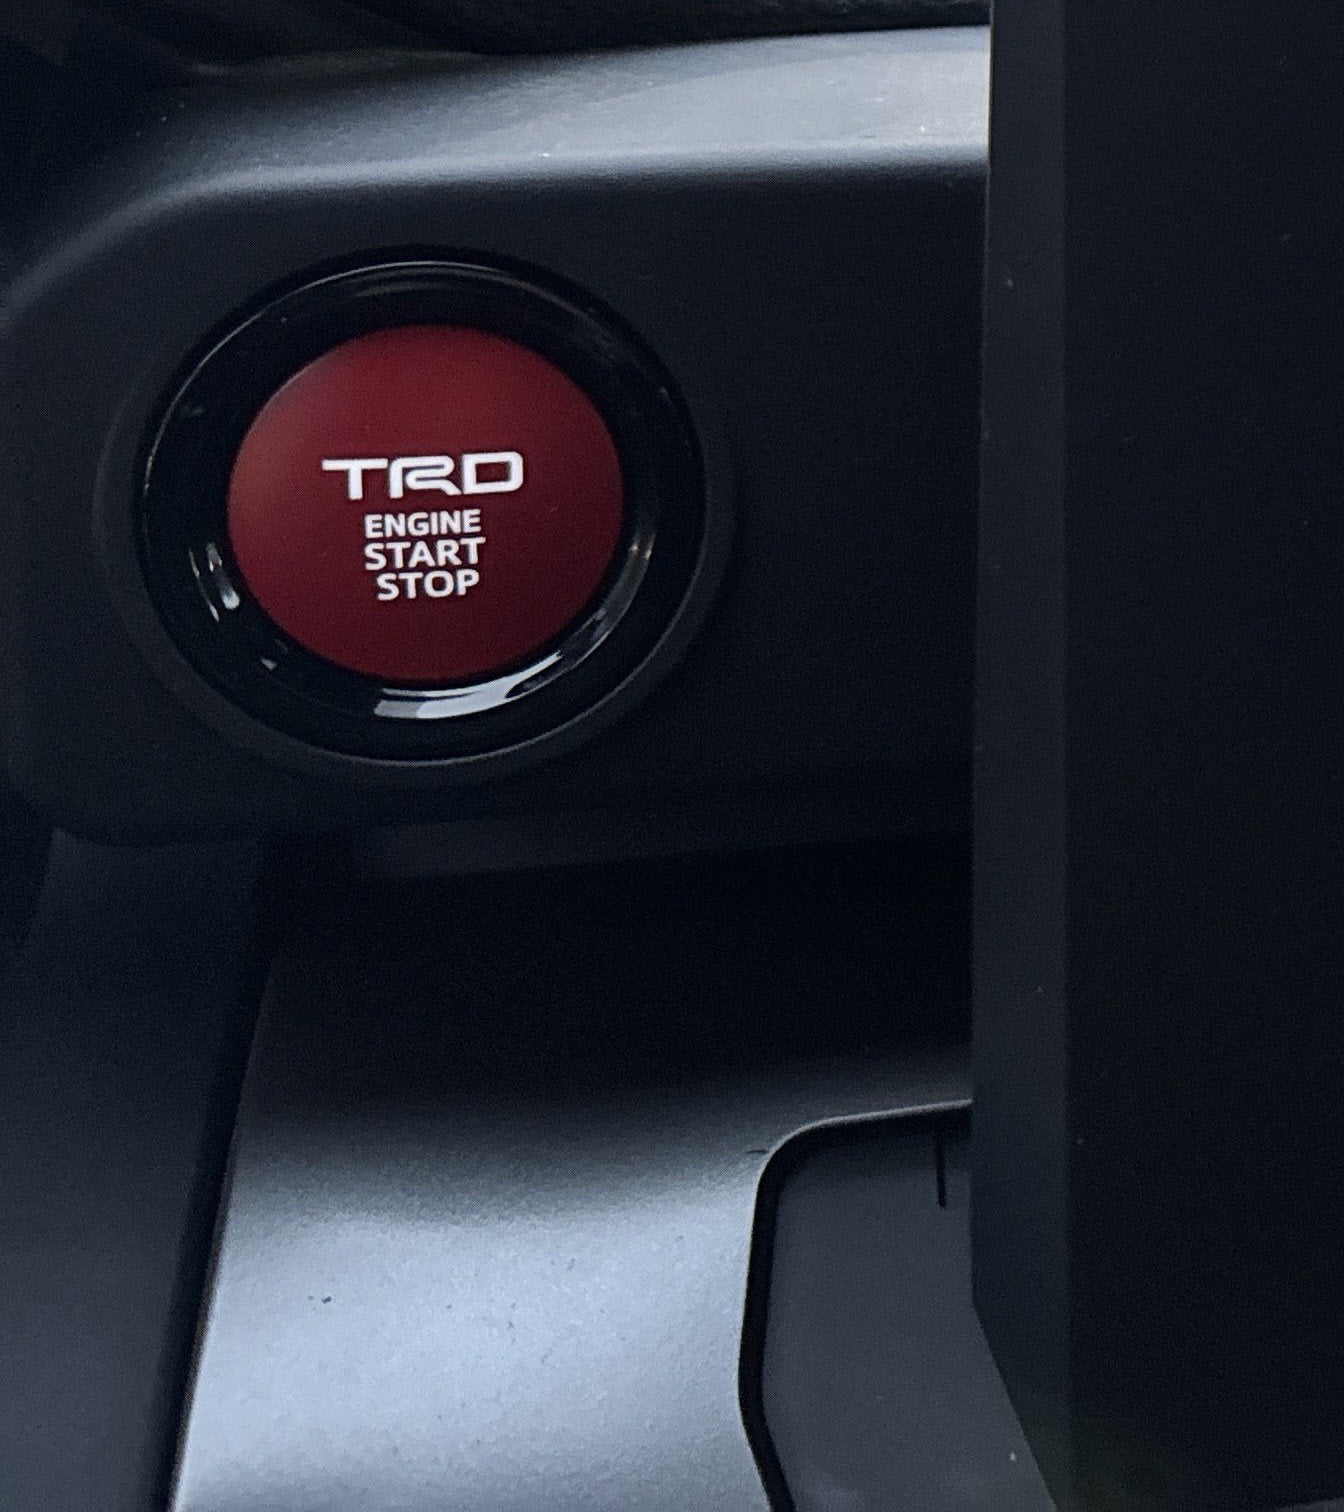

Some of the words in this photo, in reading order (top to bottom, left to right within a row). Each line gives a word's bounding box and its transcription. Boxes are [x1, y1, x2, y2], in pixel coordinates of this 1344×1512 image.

[322, 451, 523, 501] TRD
[365, 509, 481, 539] ENGINE
[364, 537, 486, 569] START
[377, 569, 480, 601] STOP
